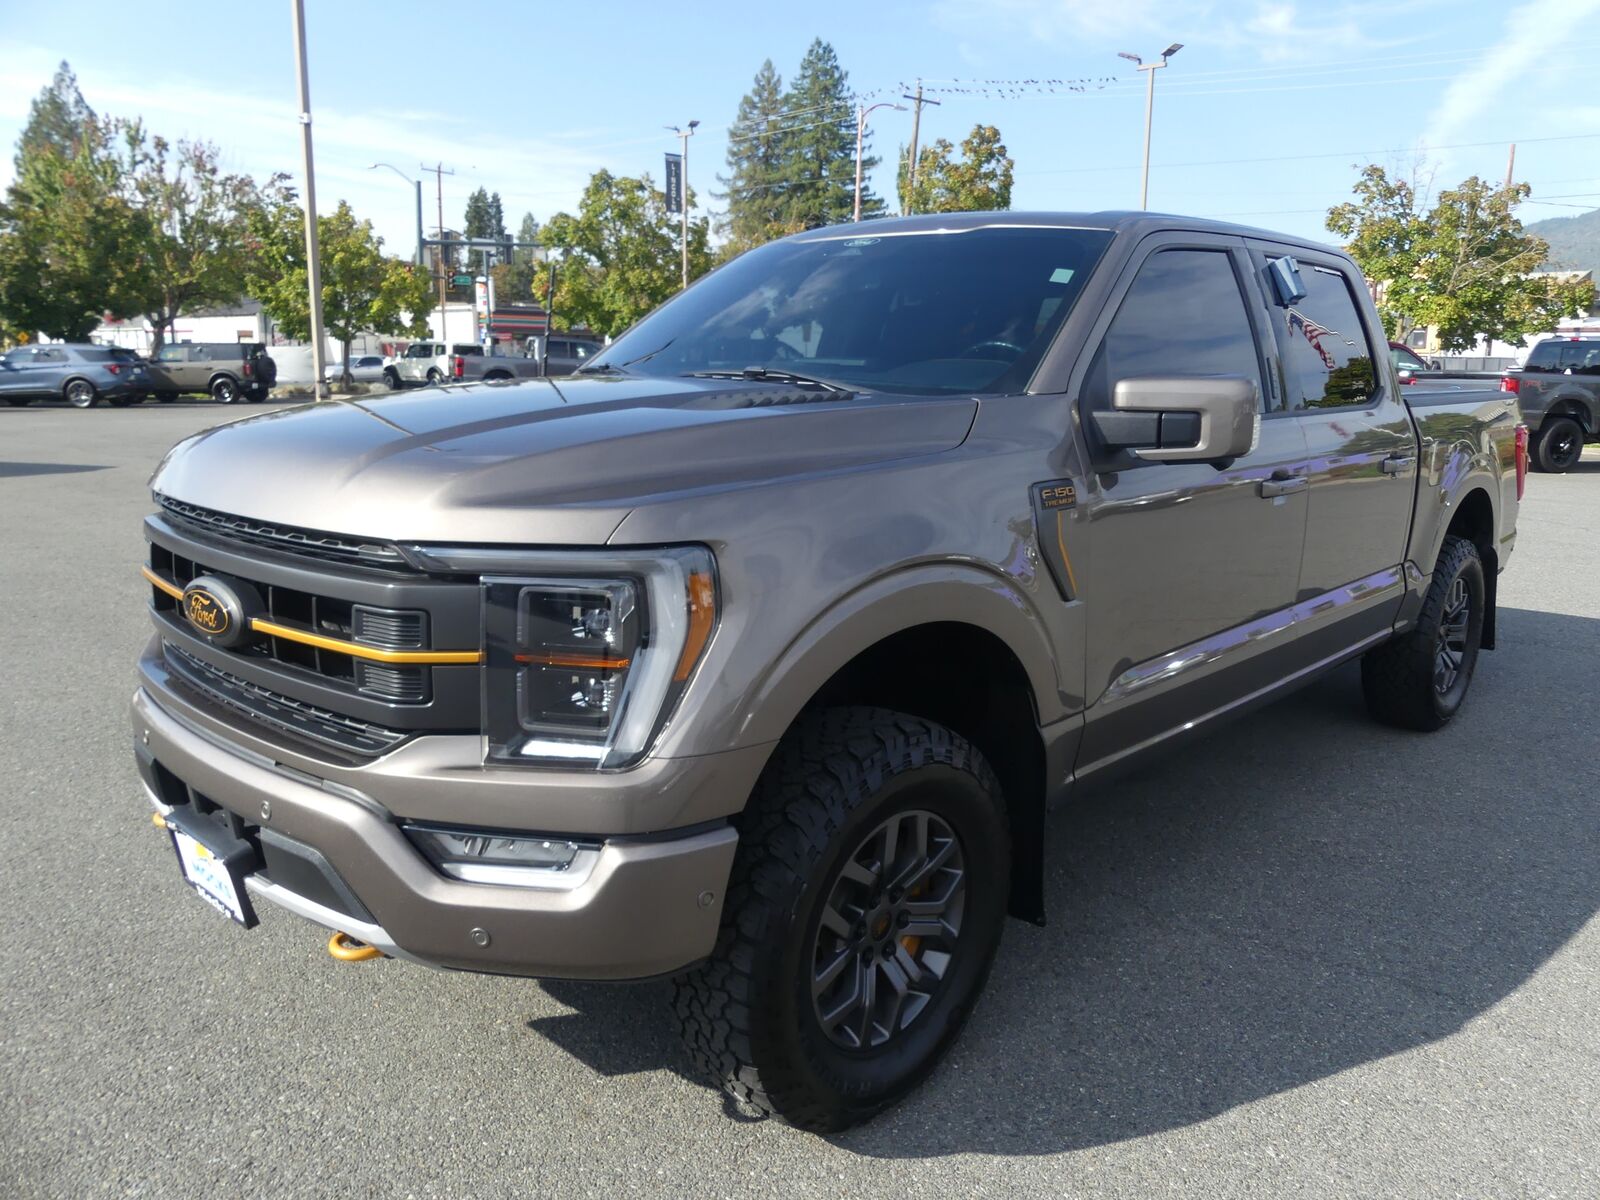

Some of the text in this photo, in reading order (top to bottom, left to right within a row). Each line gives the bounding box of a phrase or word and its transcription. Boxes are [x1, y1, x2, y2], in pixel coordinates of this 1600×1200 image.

[1041, 486, 1075, 499] F-150
[1044, 497, 1075, 507] TREMOR
[190, 594, 217, 628] Ford
